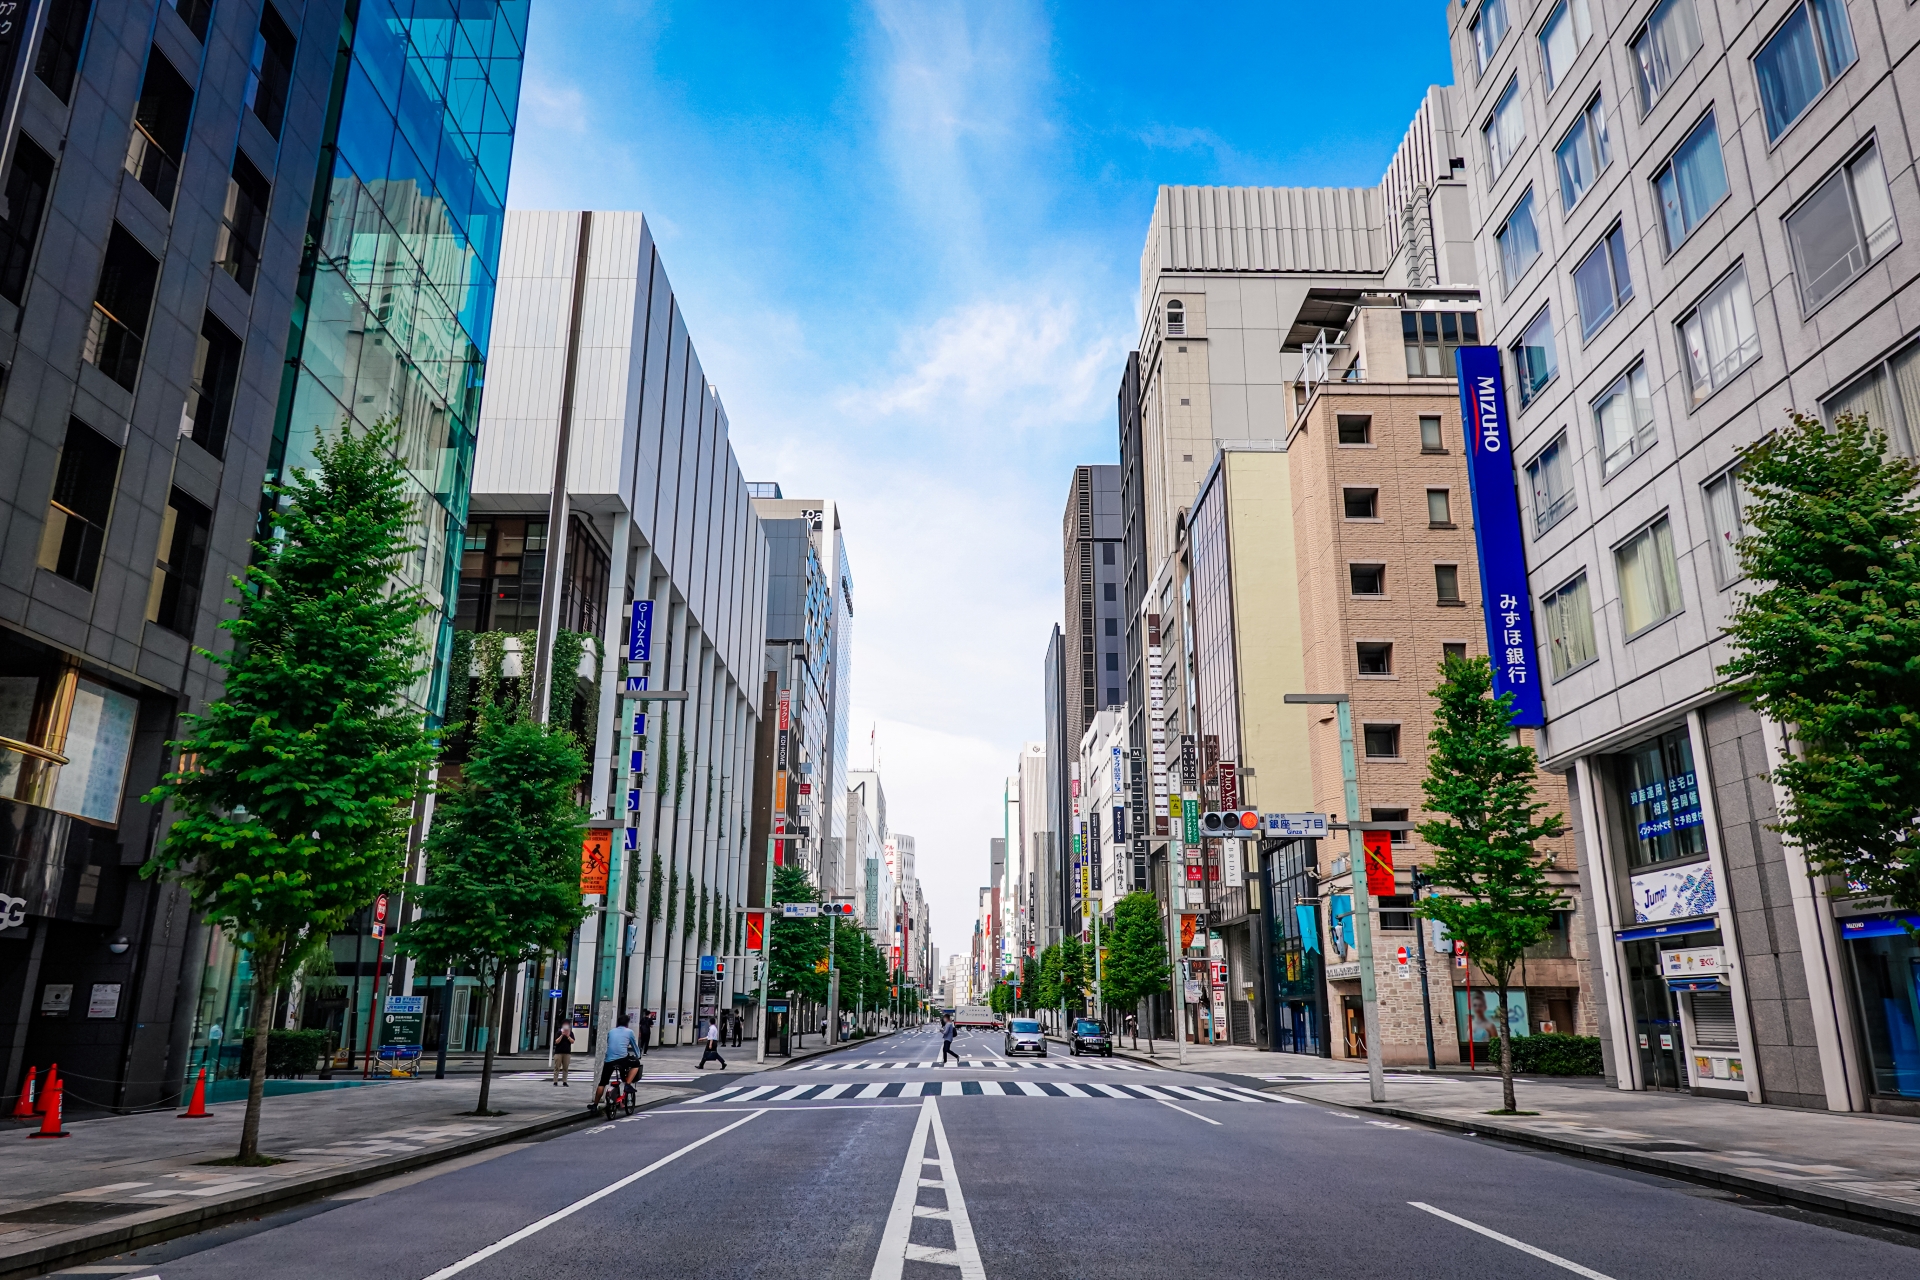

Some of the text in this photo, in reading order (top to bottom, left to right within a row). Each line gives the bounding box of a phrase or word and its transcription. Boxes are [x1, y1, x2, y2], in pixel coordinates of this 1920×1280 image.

[1477, 376, 1500, 452] MIZUHO
[1500, 594, 1526, 684] みずほ銀行
[1225, 769, 1235, 790] Duo
[1269, 819, 1323, 830] 銀座一丁目
[1228, 847, 1236, 883] BRIDAL
[1644, 885, 1667, 908] Jump!
